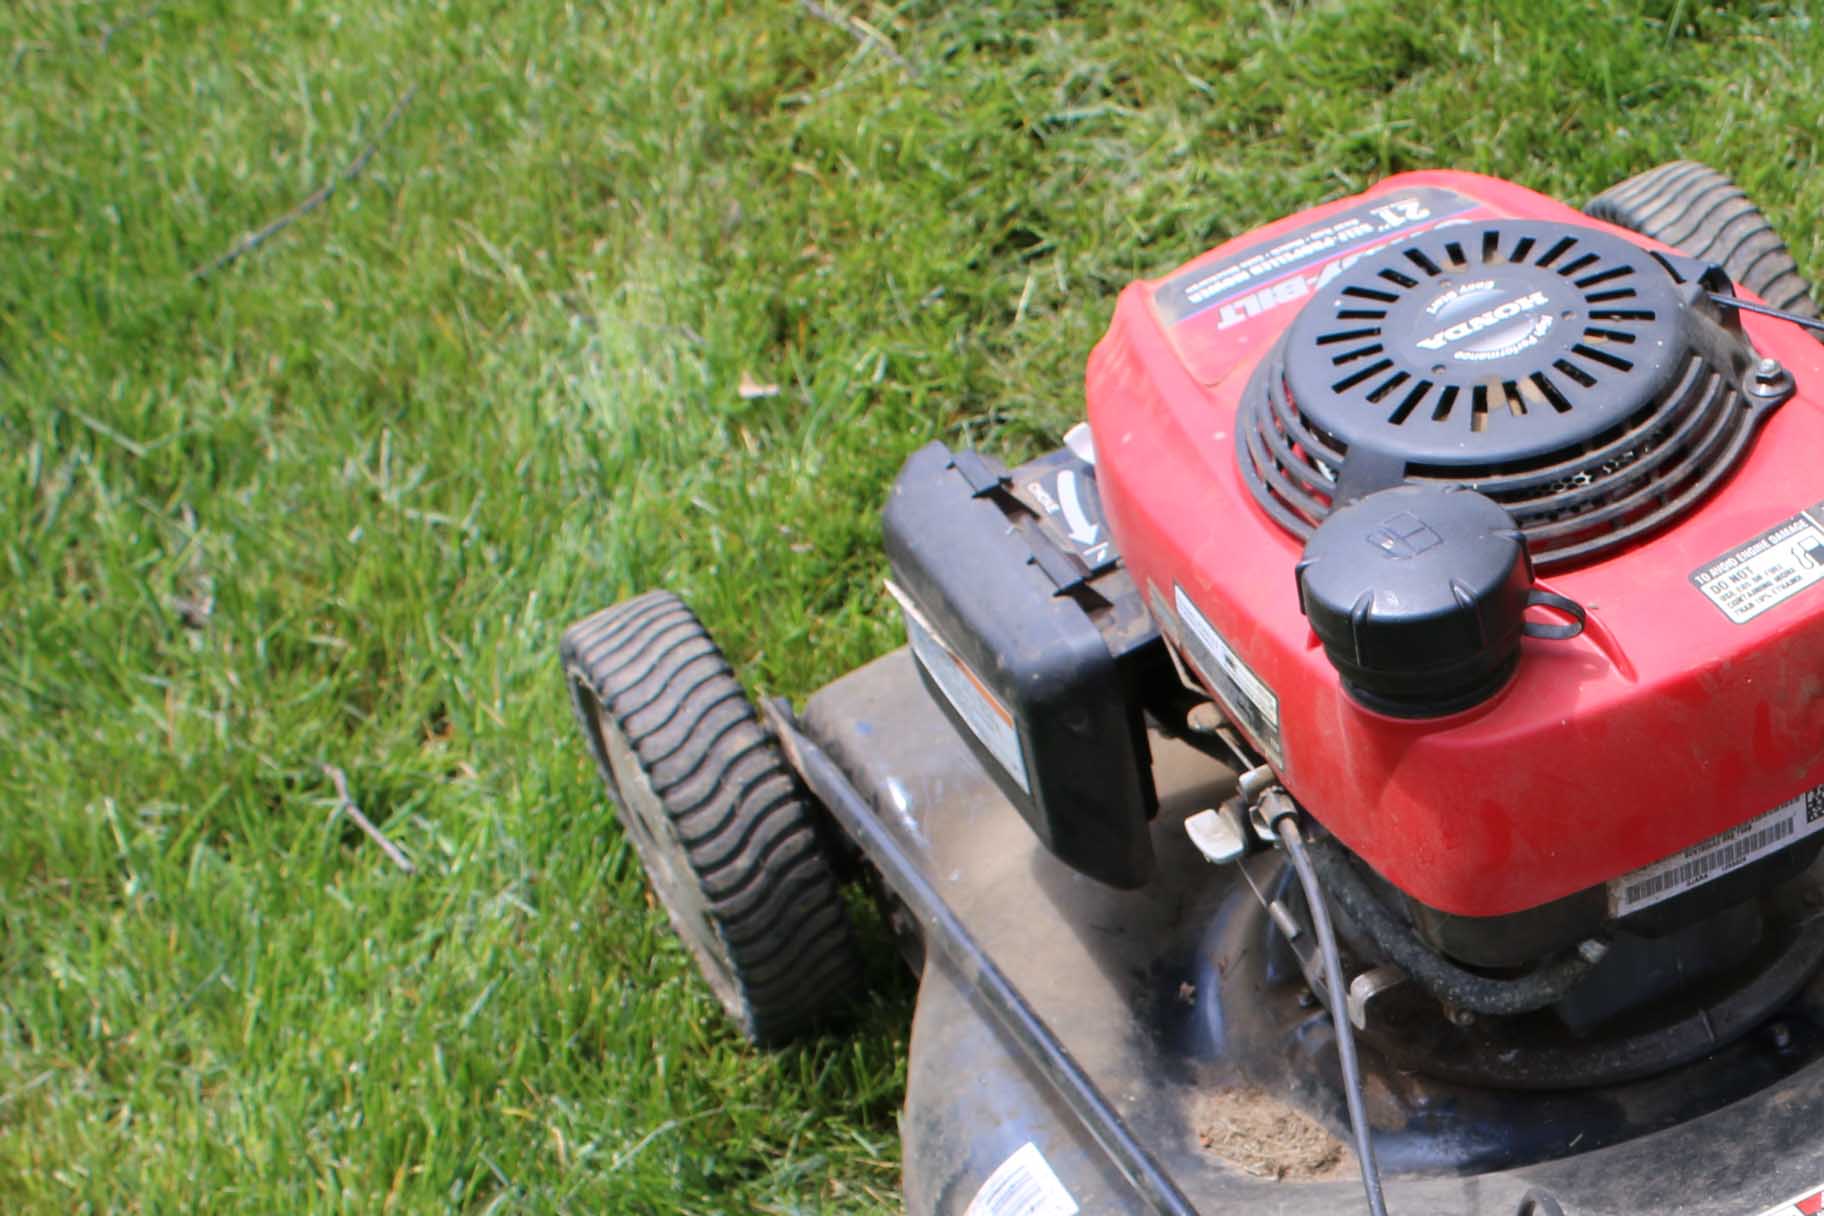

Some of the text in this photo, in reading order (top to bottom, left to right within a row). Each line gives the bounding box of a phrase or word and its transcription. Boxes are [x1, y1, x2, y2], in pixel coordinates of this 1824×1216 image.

[1416, 291, 1549, 350] HONDA
[1693, 517, 1809, 584] TO AVOID ENGINE DAMAGE
[1708, 565, 1755, 595] DO NOT
